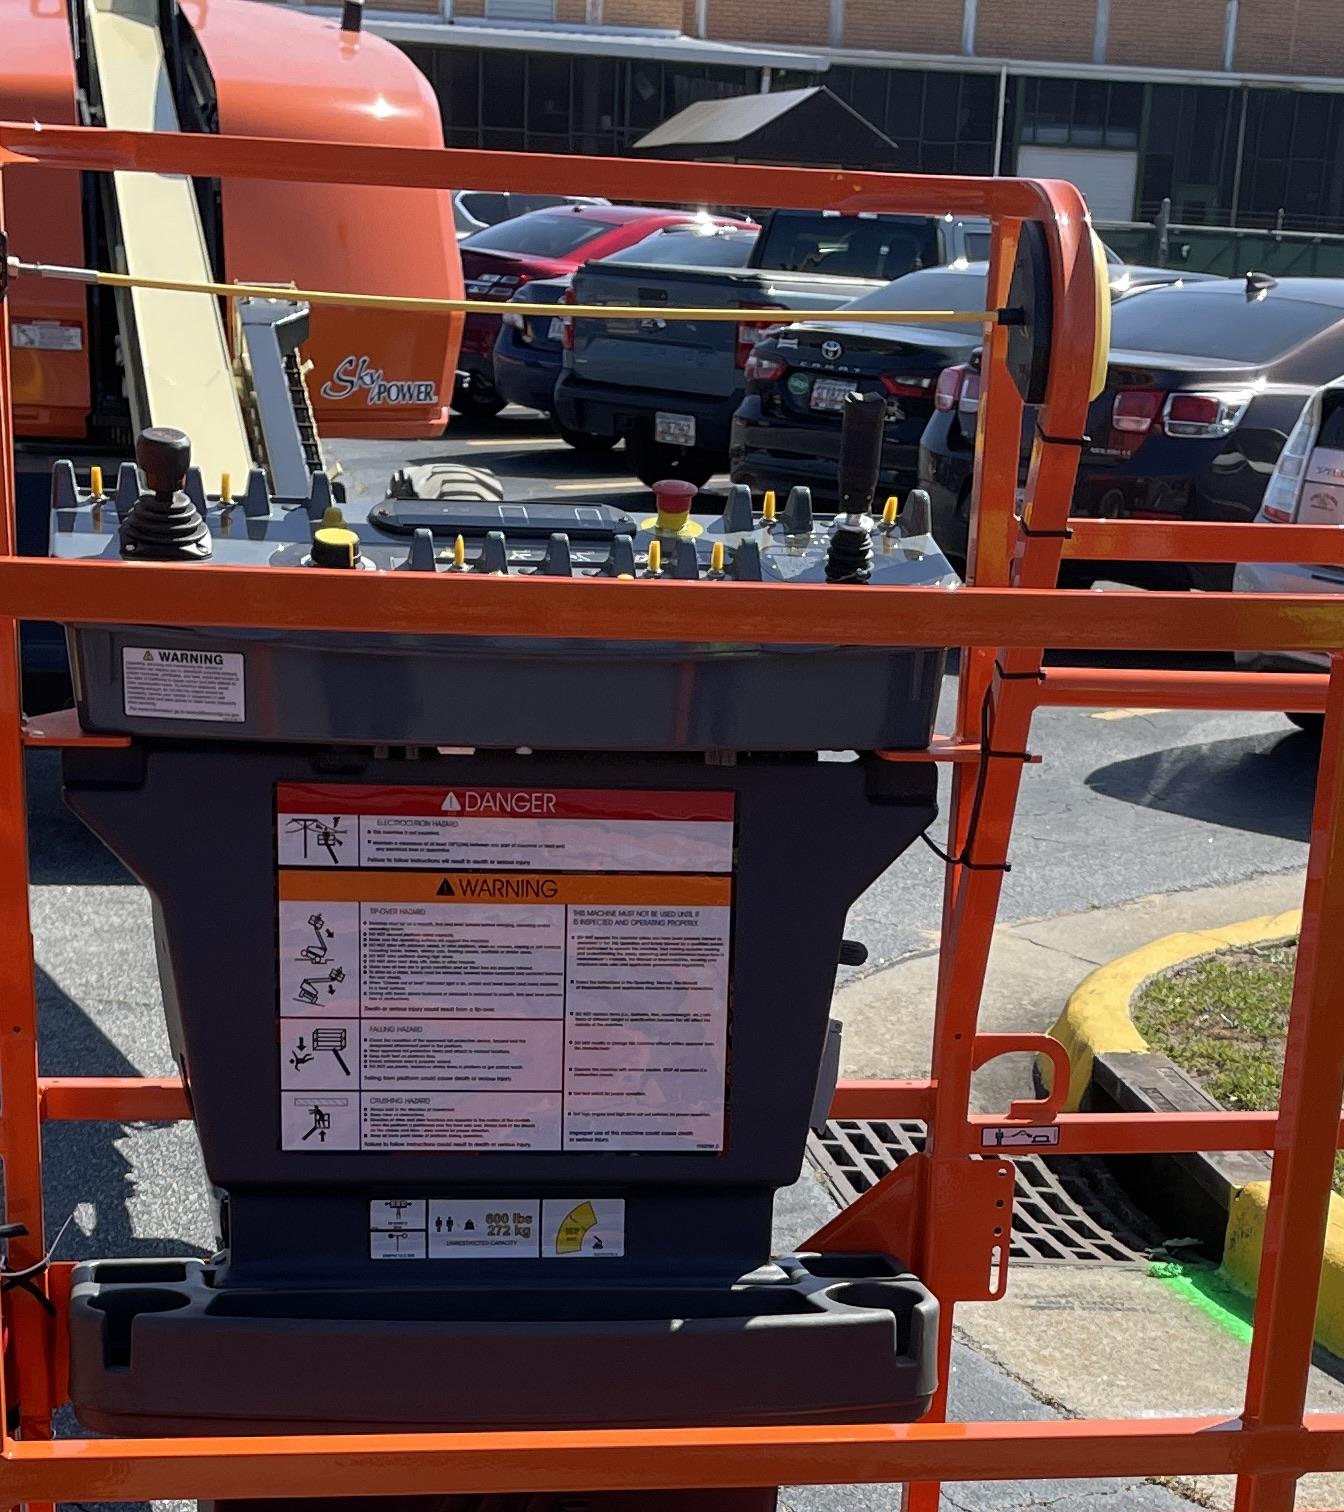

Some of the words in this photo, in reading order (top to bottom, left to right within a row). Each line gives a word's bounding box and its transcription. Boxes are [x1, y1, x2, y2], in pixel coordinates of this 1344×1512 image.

[321, 356, 383, 404] Sky
[376, 383, 434, 402] POWER
[158, 651, 224, 665] WARNING
[464, 793, 556, 813] DANGER
[432, 820, 459, 828] HAZARD
[459, 878, 558, 898] WARNING
[399, 908, 426, 916] HAZARD
[485, 1213, 509, 1225] 600
[512, 1213, 533, 1225] lbs
[487, 1225, 510, 1237] 272
[514, 1224, 531, 1239] kg
